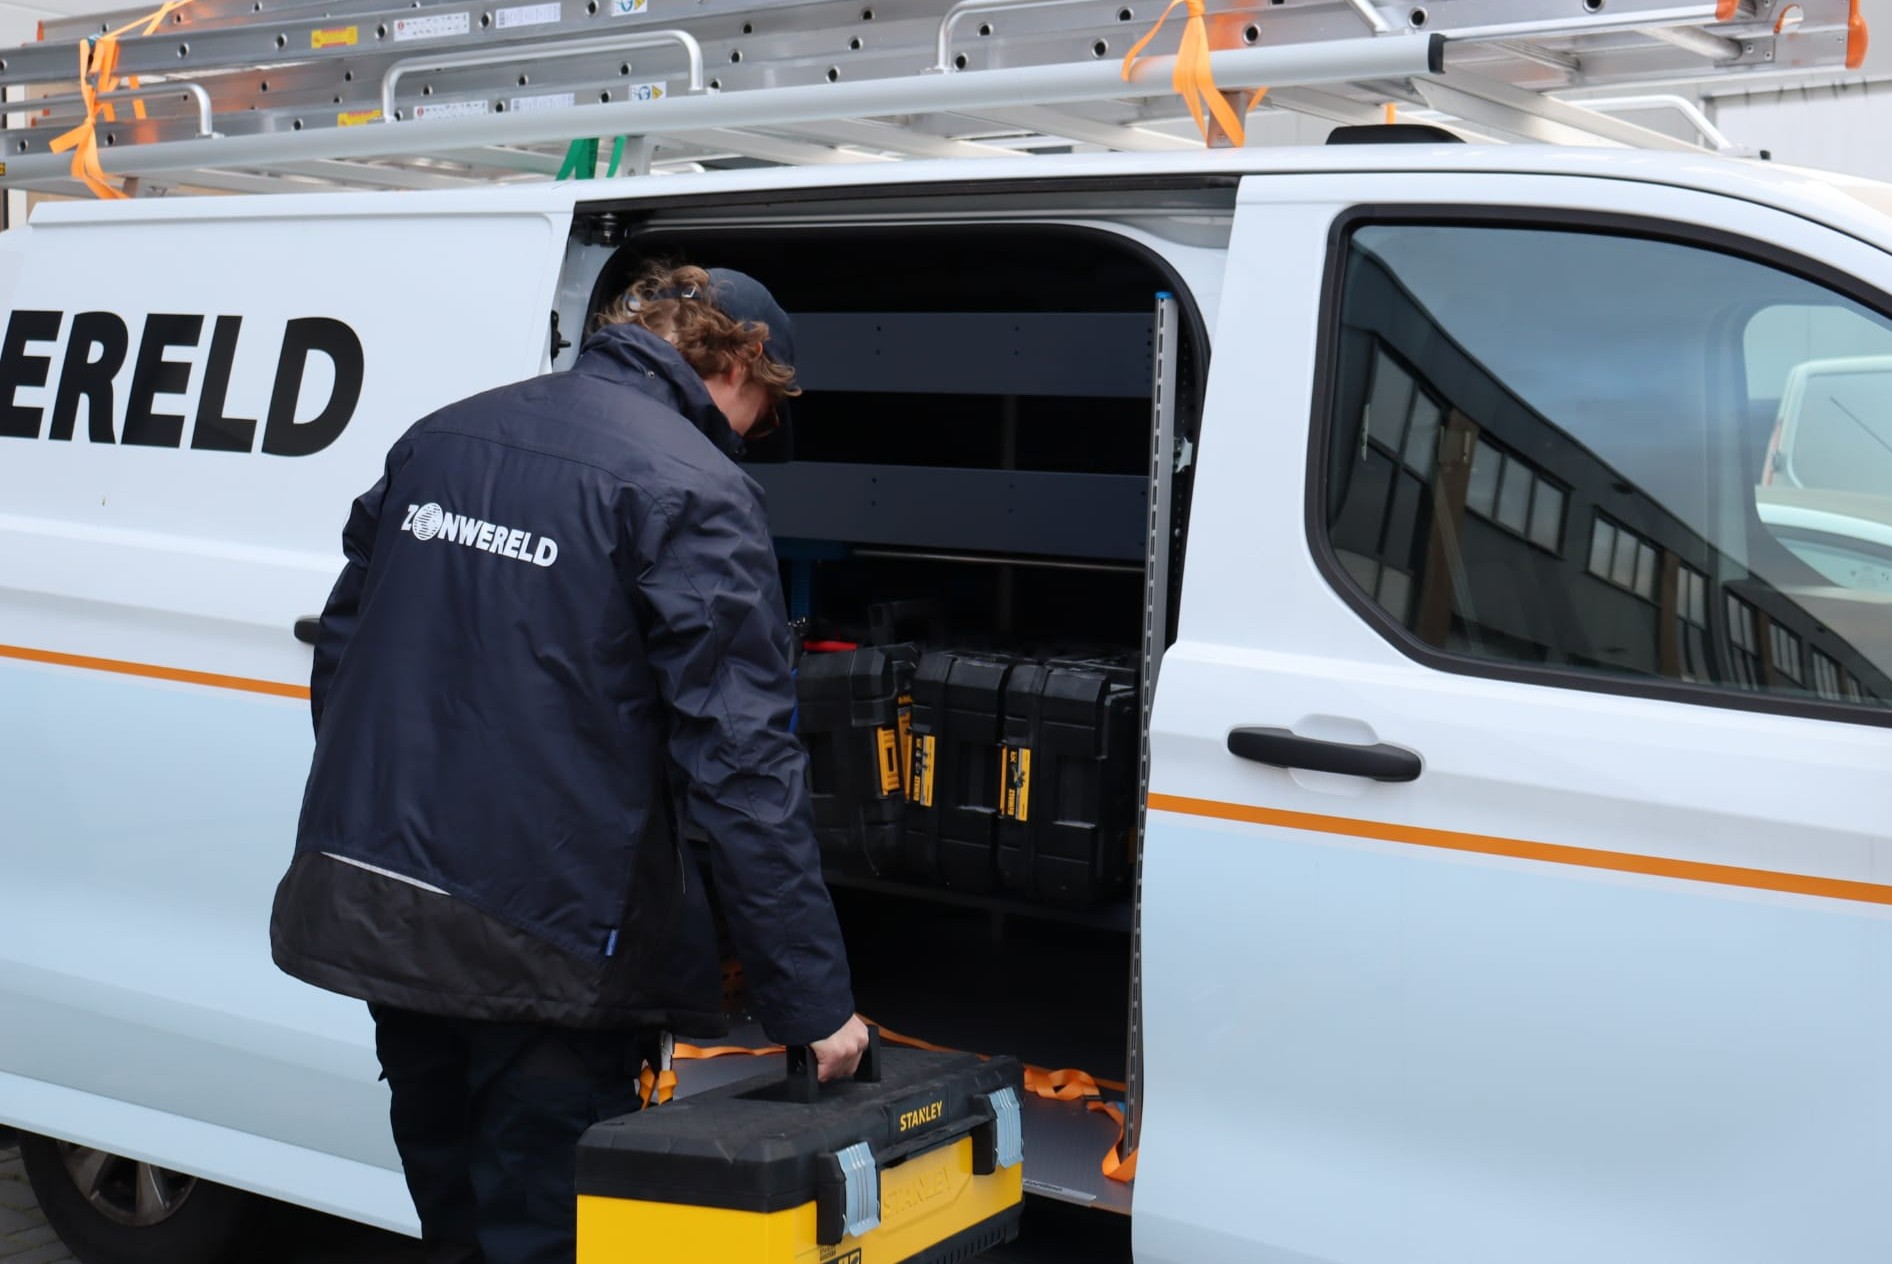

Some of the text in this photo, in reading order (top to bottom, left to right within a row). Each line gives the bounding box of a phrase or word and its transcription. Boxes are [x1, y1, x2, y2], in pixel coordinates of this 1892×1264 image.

[0, 310, 364, 457] ERELD
[400, 502, 558, 567] ZONWERELD
[899, 1100, 943, 1132] STANLEY
[883, 1166, 951, 1218] STANLEY
